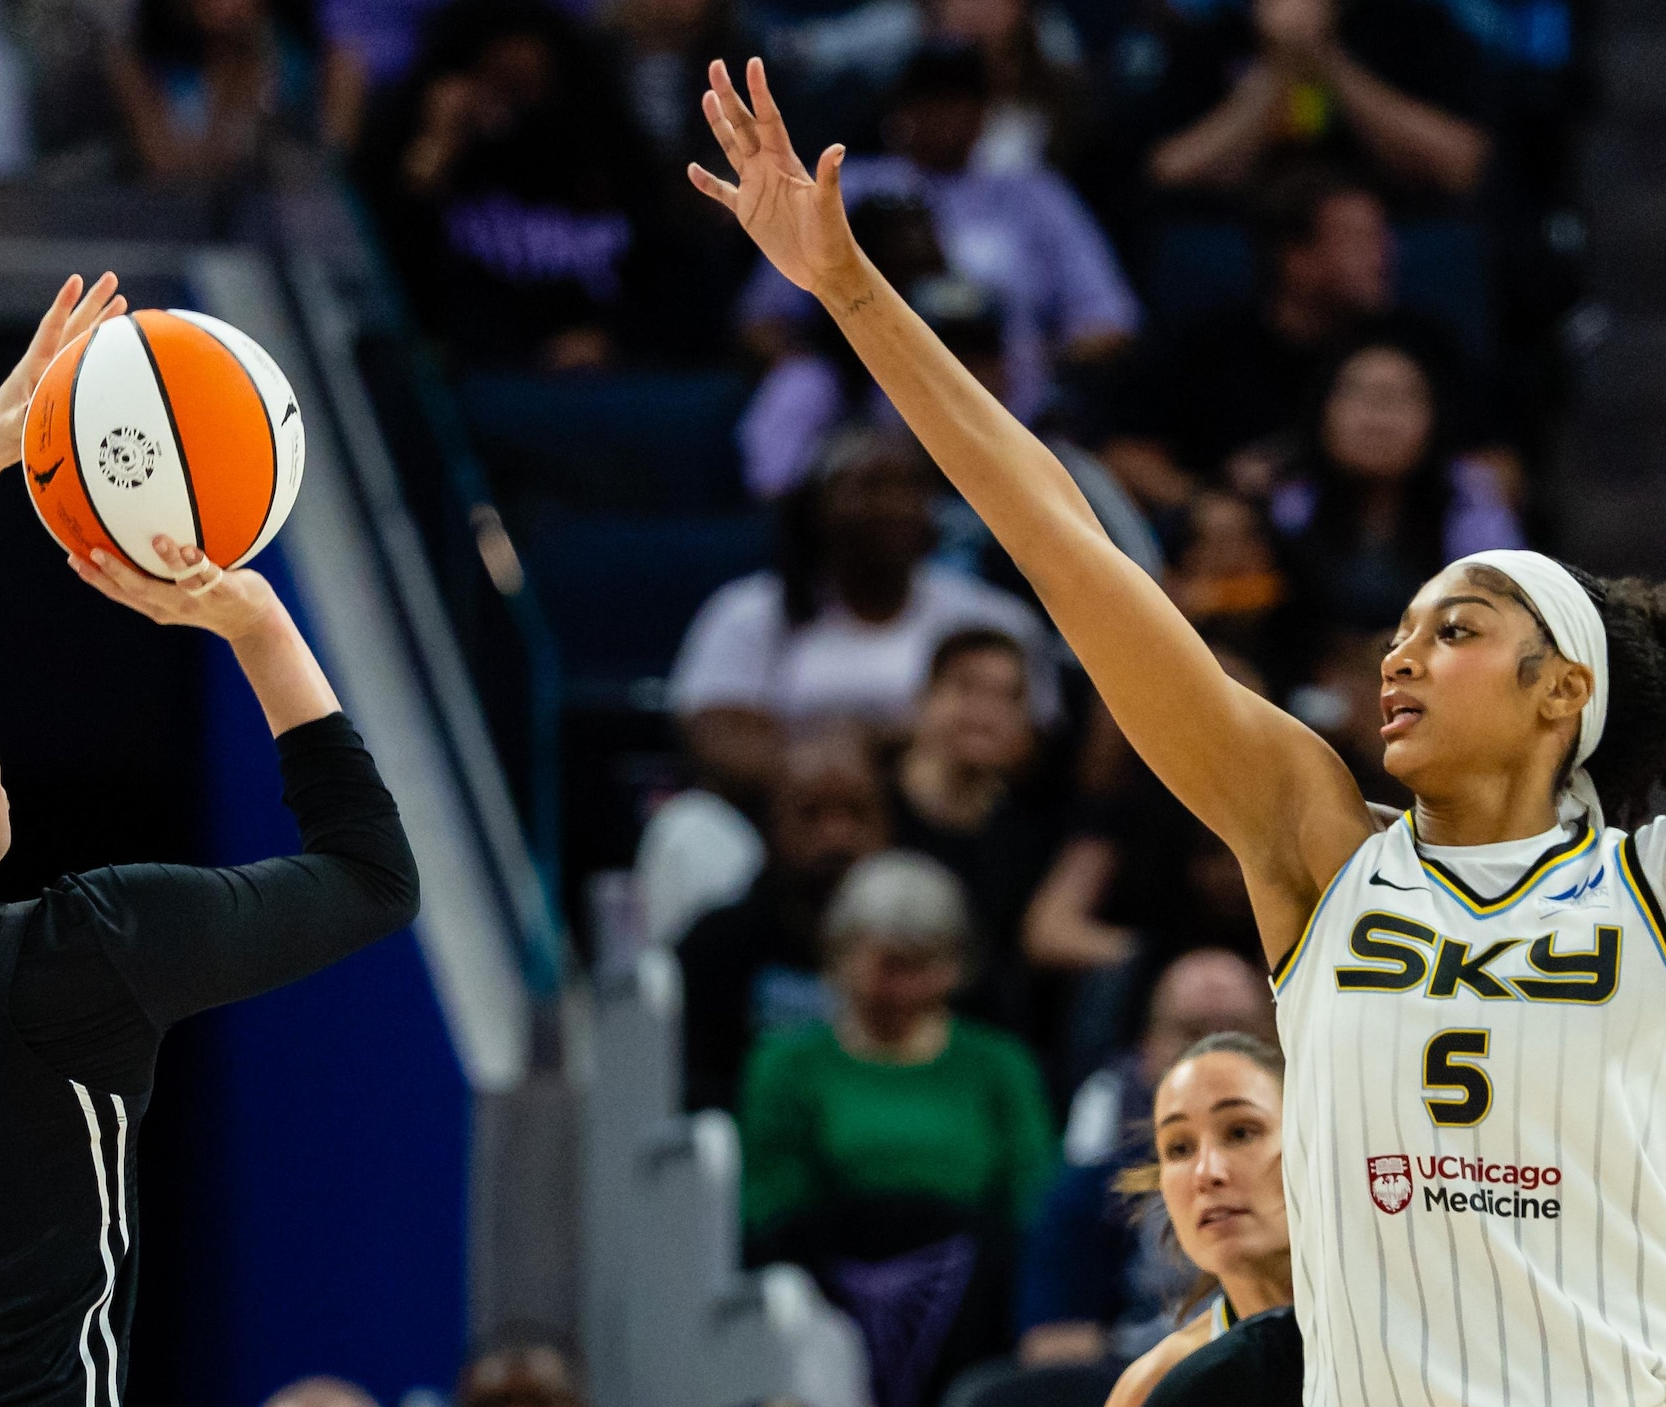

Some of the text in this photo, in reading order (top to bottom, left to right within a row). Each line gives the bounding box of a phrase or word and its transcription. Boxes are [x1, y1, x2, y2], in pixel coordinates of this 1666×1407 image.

[1334, 911, 1623, 1005] SKY
[1421, 1027, 1493, 1127] 5
[1416, 1155, 1562, 1190] UChicago
[1423, 1186, 1561, 1219] Medicine
